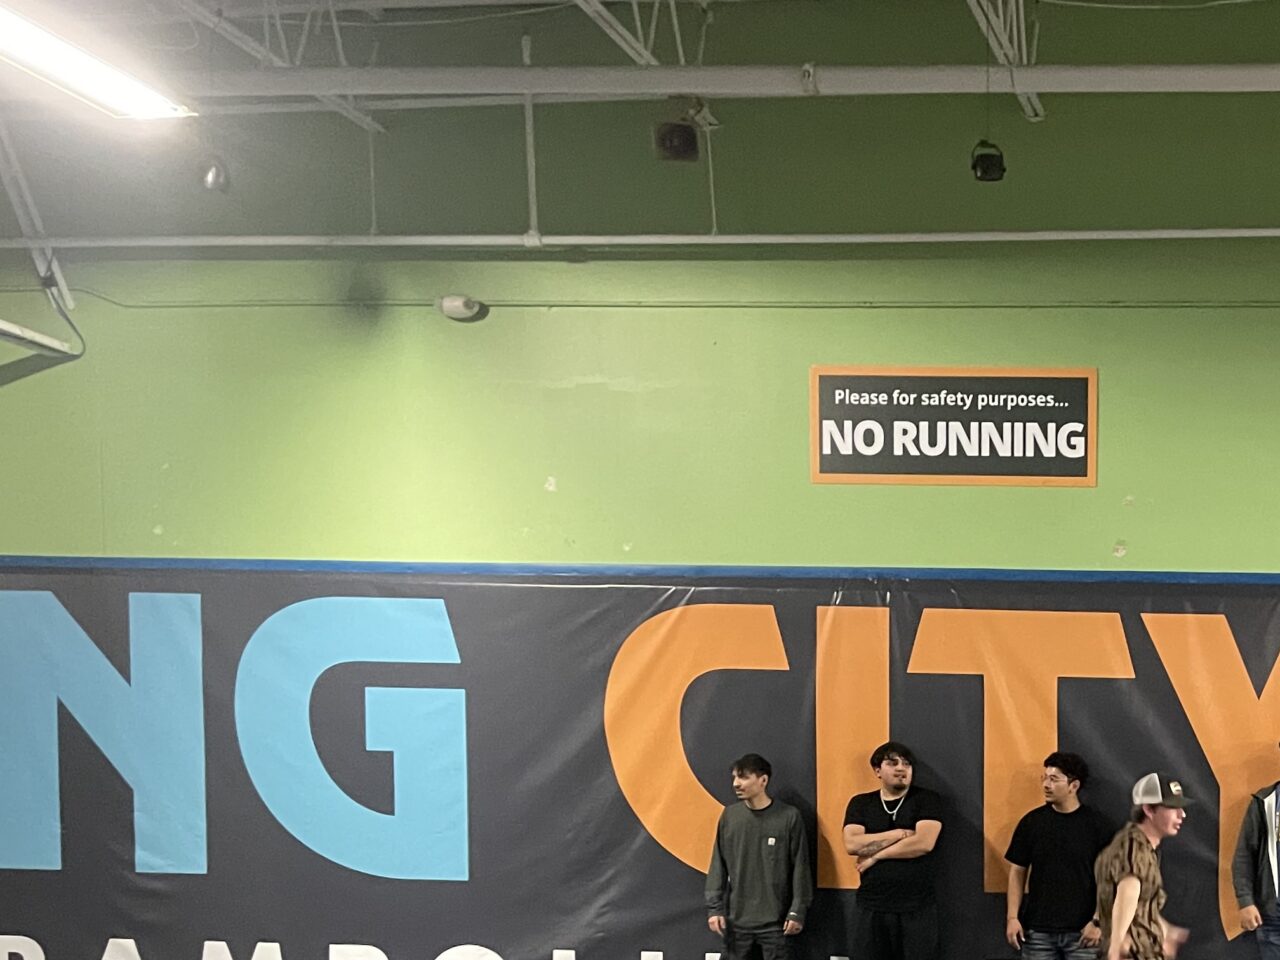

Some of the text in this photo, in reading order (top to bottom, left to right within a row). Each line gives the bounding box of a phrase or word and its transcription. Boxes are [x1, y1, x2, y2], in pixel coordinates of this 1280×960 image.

[834, 389, 1069, 411] Please for safety purposes...
[822, 420, 1086, 458] NO RUNNING
